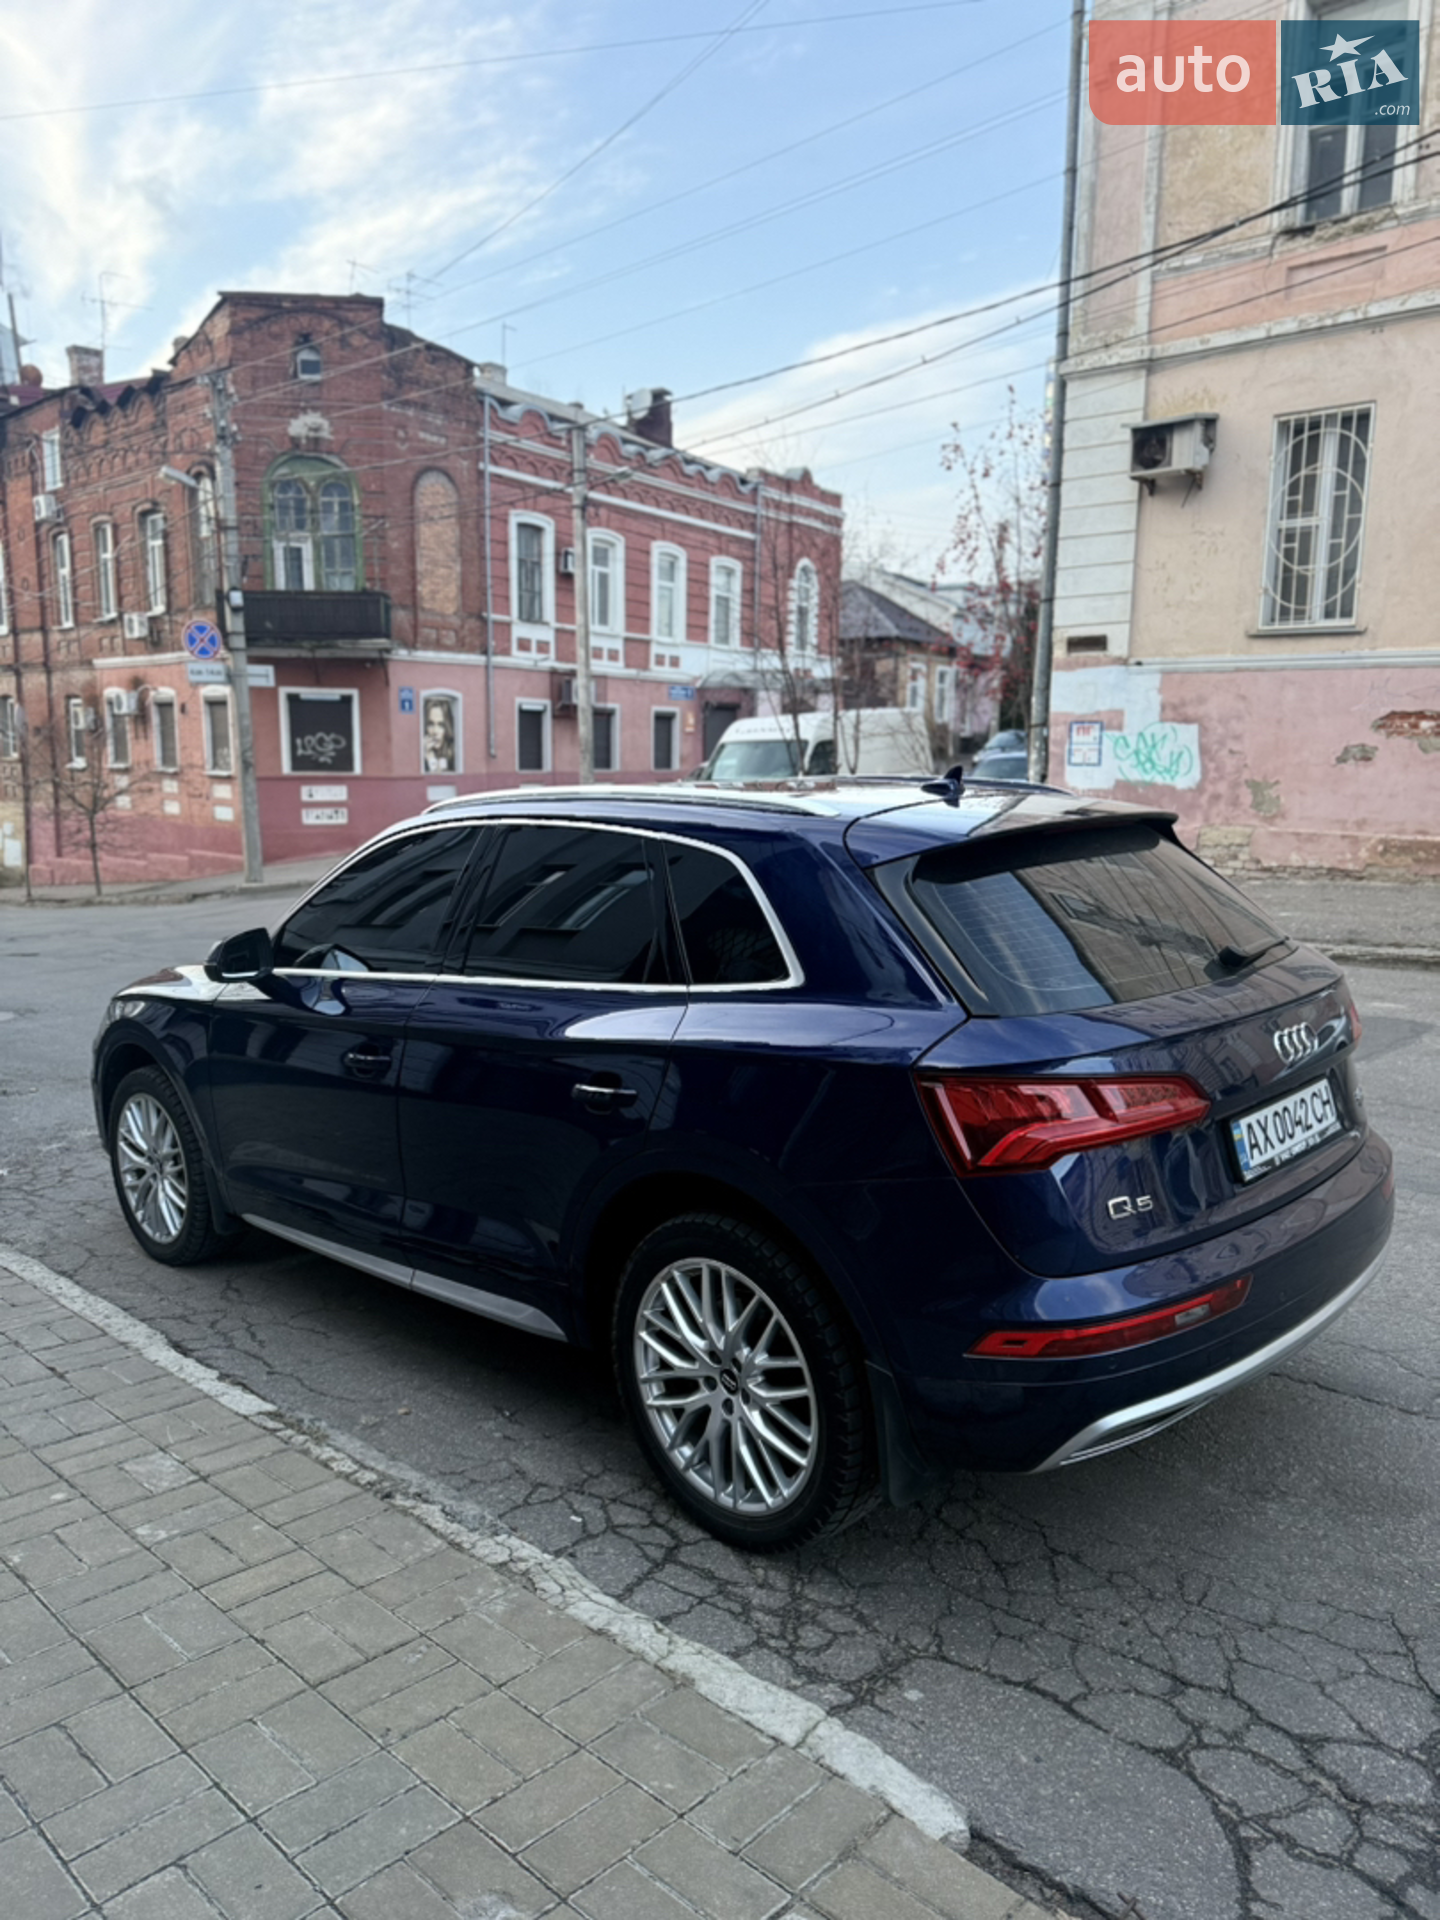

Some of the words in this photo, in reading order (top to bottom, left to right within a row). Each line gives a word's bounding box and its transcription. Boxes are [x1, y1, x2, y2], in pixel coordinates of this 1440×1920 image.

[1246, 1114, 1275, 1160] AX
[1272, 1098, 1313, 1144] 0042
[1311, 1085, 1334, 1123] CH
[1107, 1195, 1153, 1220] Q5
